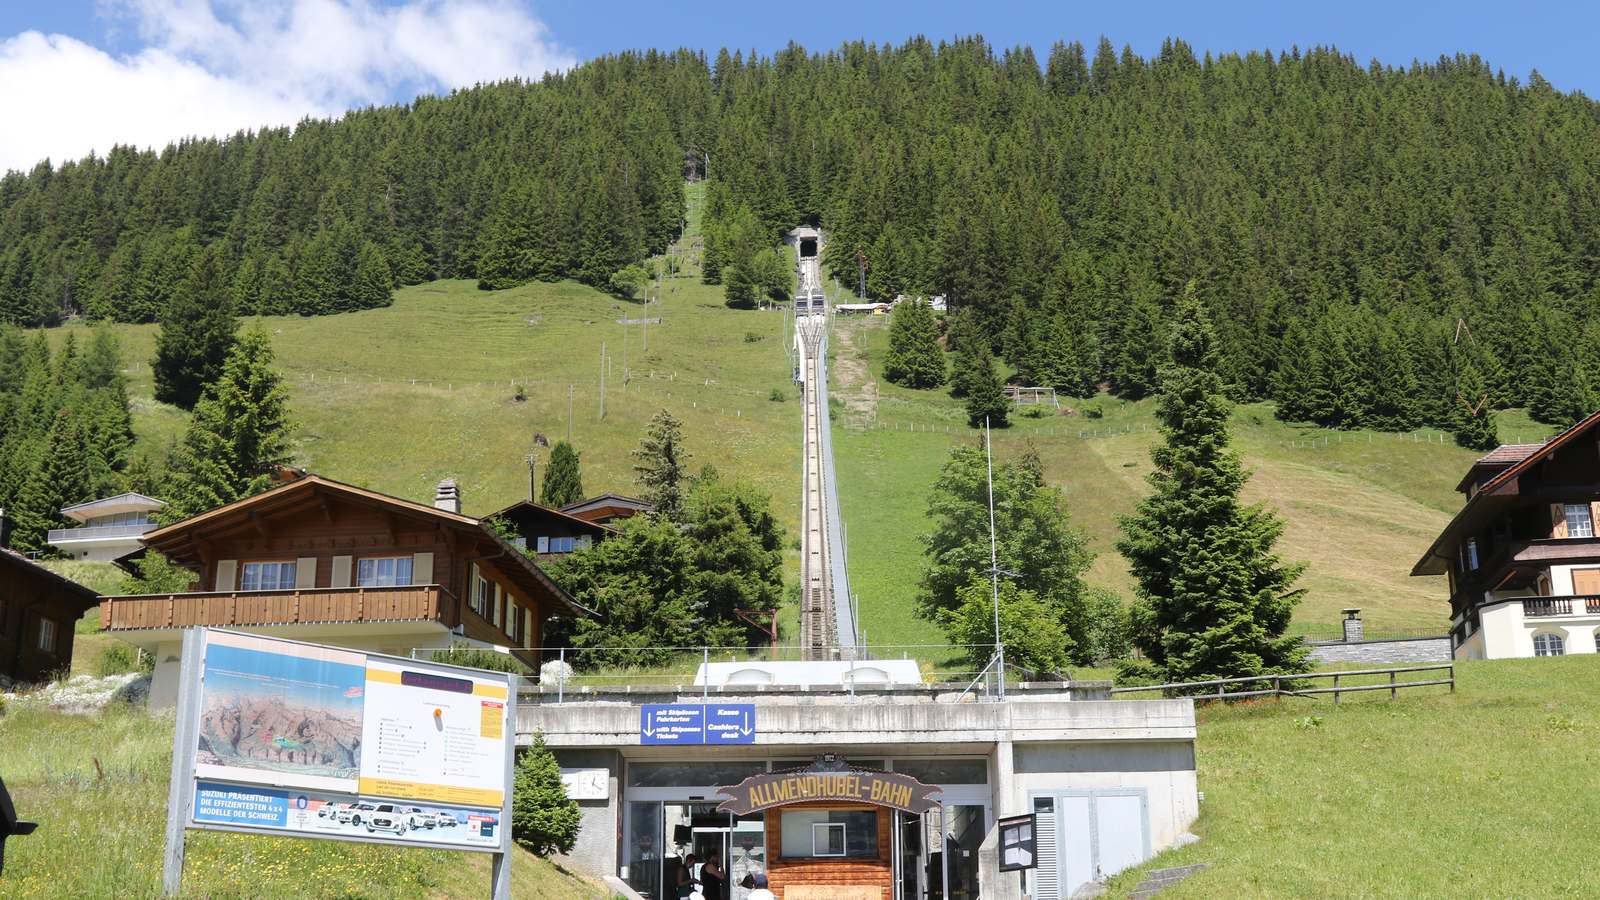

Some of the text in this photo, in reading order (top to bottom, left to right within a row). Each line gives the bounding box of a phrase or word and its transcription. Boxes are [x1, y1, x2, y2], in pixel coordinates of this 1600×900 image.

[201, 790, 227, 799] SUZUKI
[748, 775, 913, 809] ALLMENDHUBEL-BAHN
[200, 798, 212, 806] DIE
[213, 799, 267, 811] EFFIZIENTESTEN
[200, 807, 232, 817] MODELLE
[233, 810, 247, 818] DER
